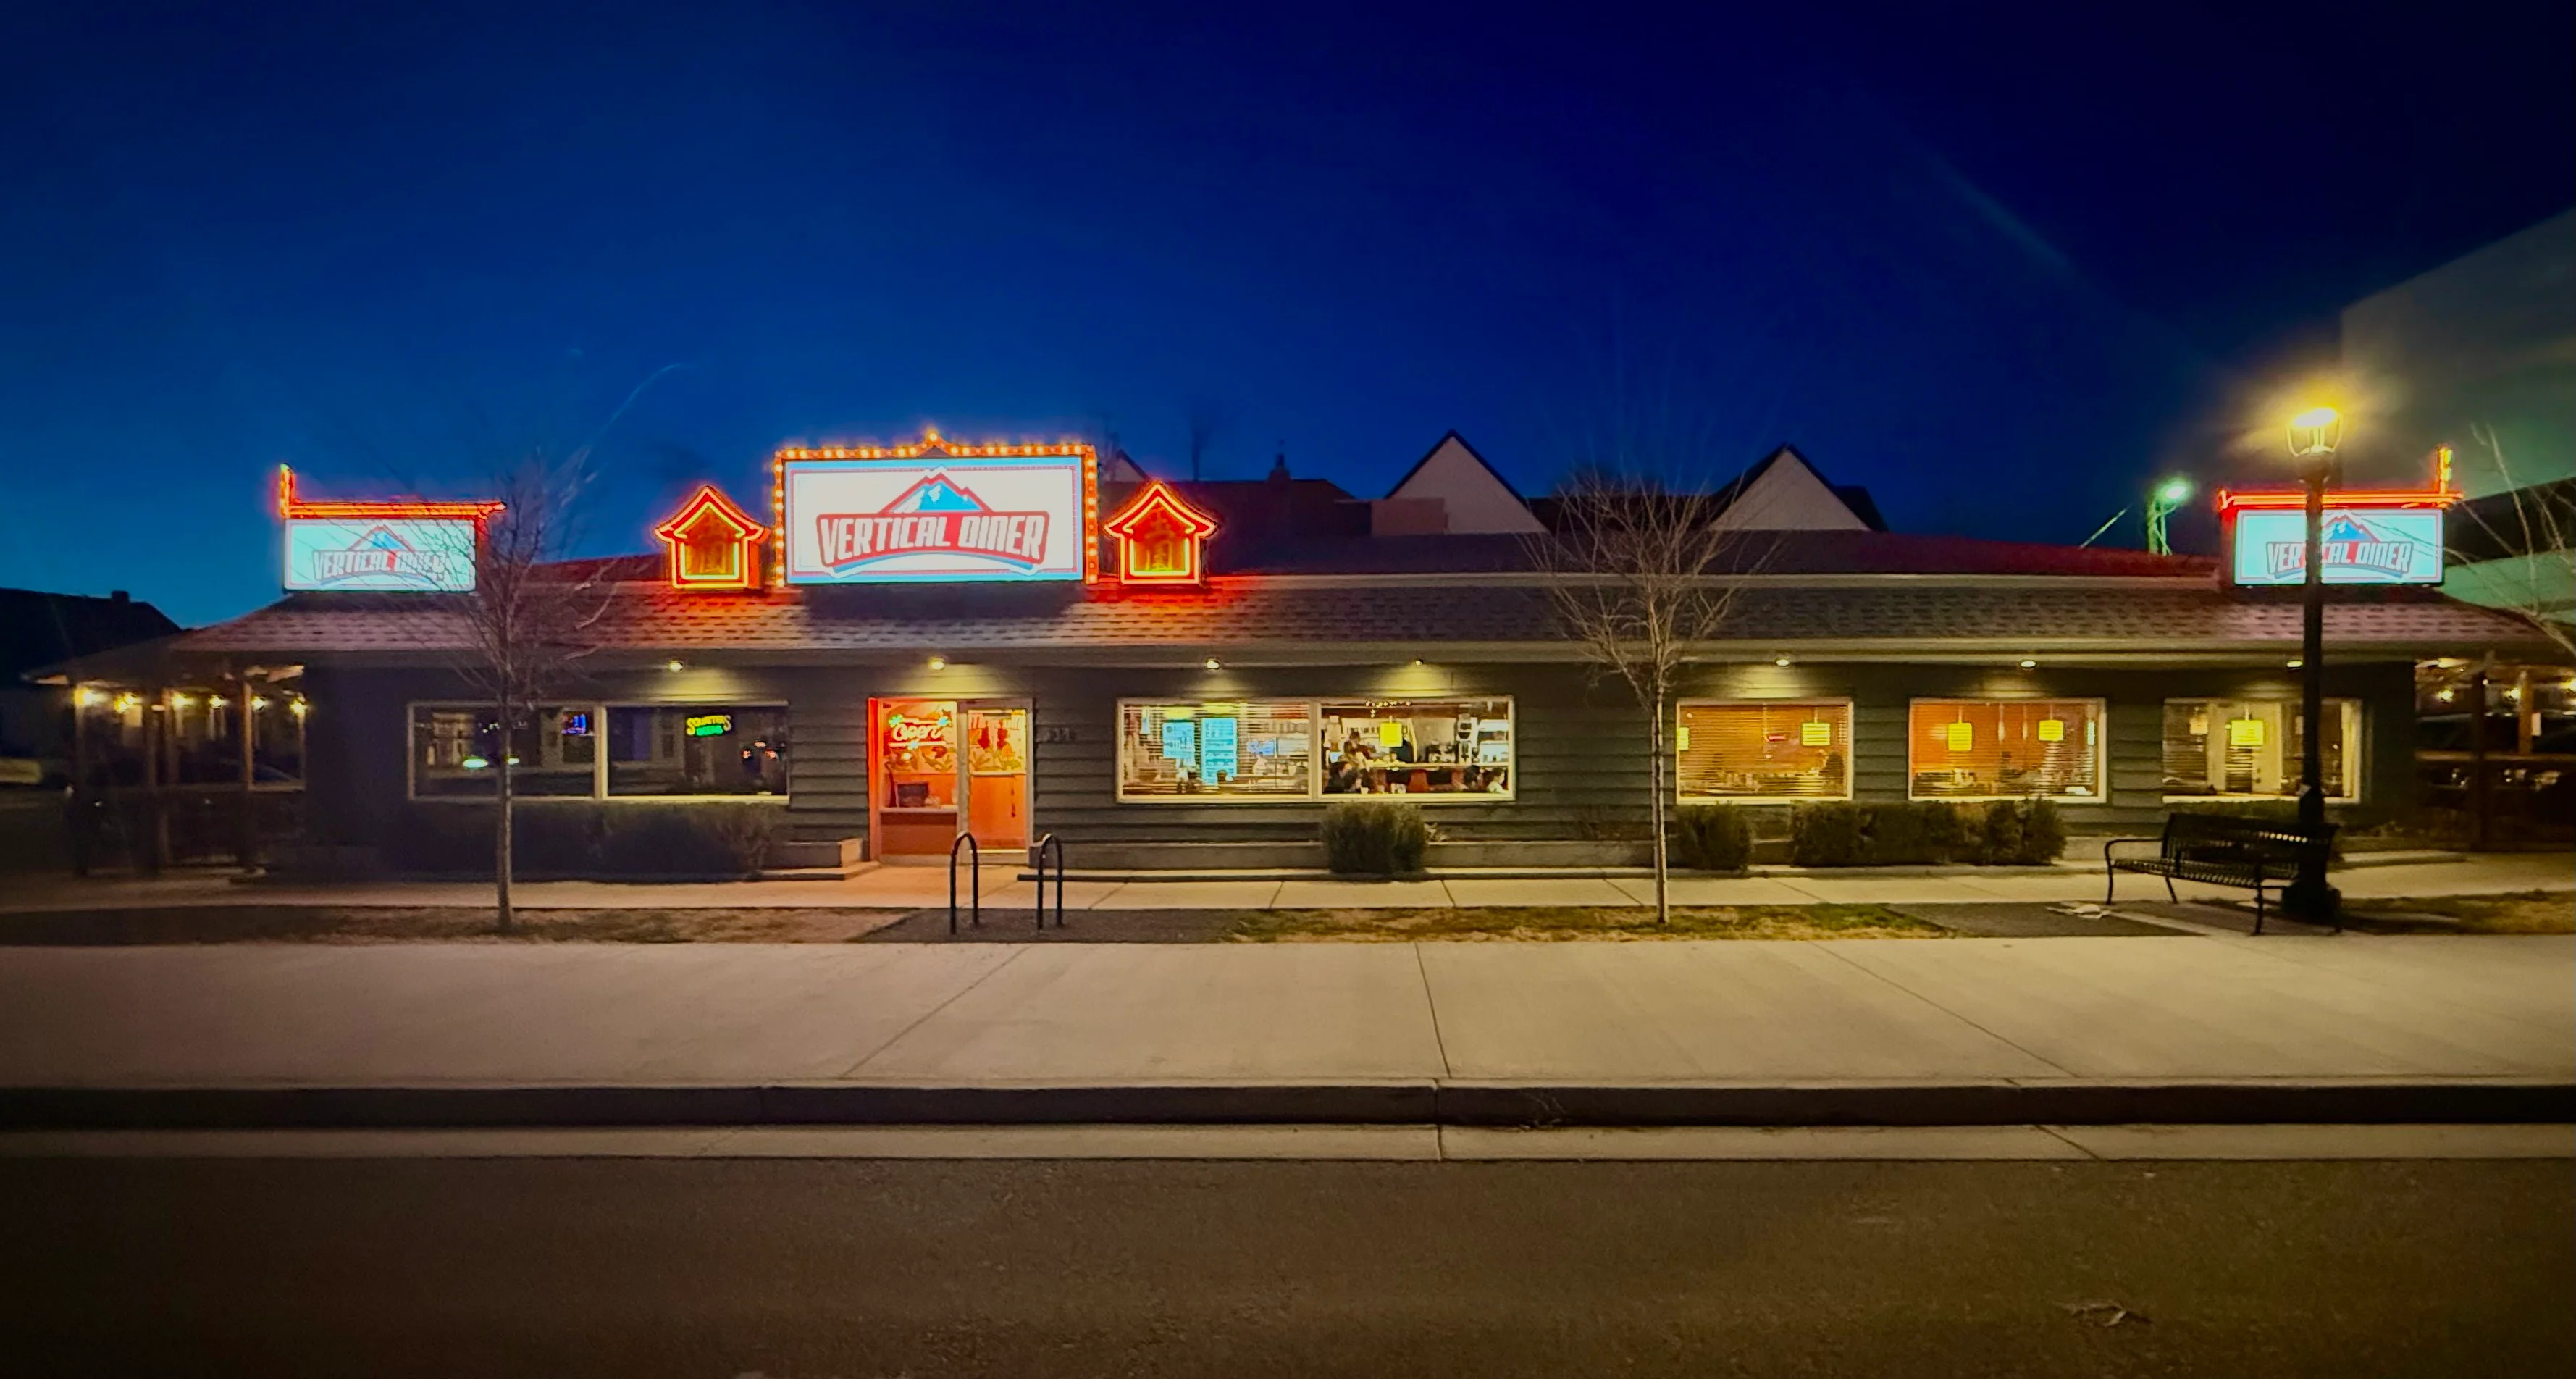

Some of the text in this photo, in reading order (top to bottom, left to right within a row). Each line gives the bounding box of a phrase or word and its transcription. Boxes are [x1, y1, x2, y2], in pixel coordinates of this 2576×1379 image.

[819, 515, 1046, 564] VERTICAL DINER
[313, 550, 392, 580] VERTICAL
[2354, 542, 2412, 573] DINER
